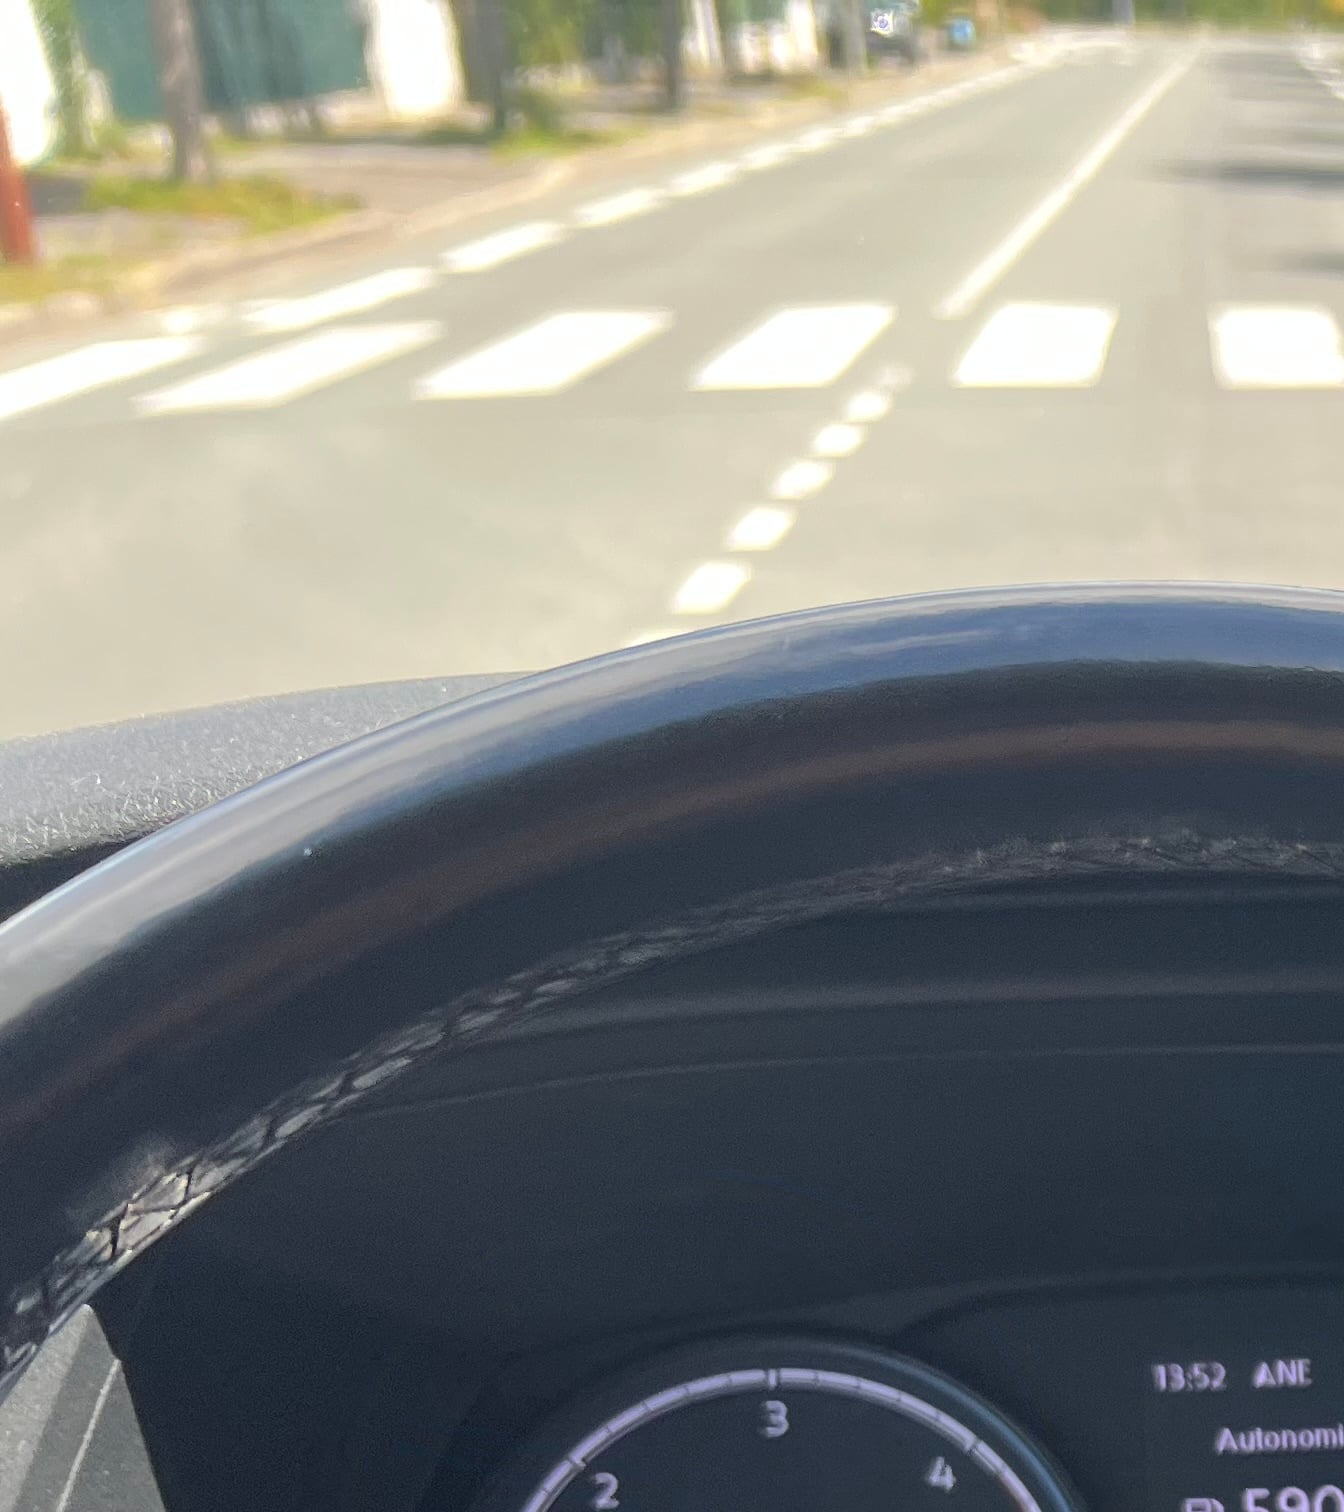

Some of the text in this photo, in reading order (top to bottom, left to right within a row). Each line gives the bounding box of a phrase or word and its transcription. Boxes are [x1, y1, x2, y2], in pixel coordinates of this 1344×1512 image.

[1151, 1362, 1227, 1391] 13:52
[762, 1400, 789, 1438] 3
[591, 1472, 620, 1510] 2
[927, 1457, 955, 1490] 4
